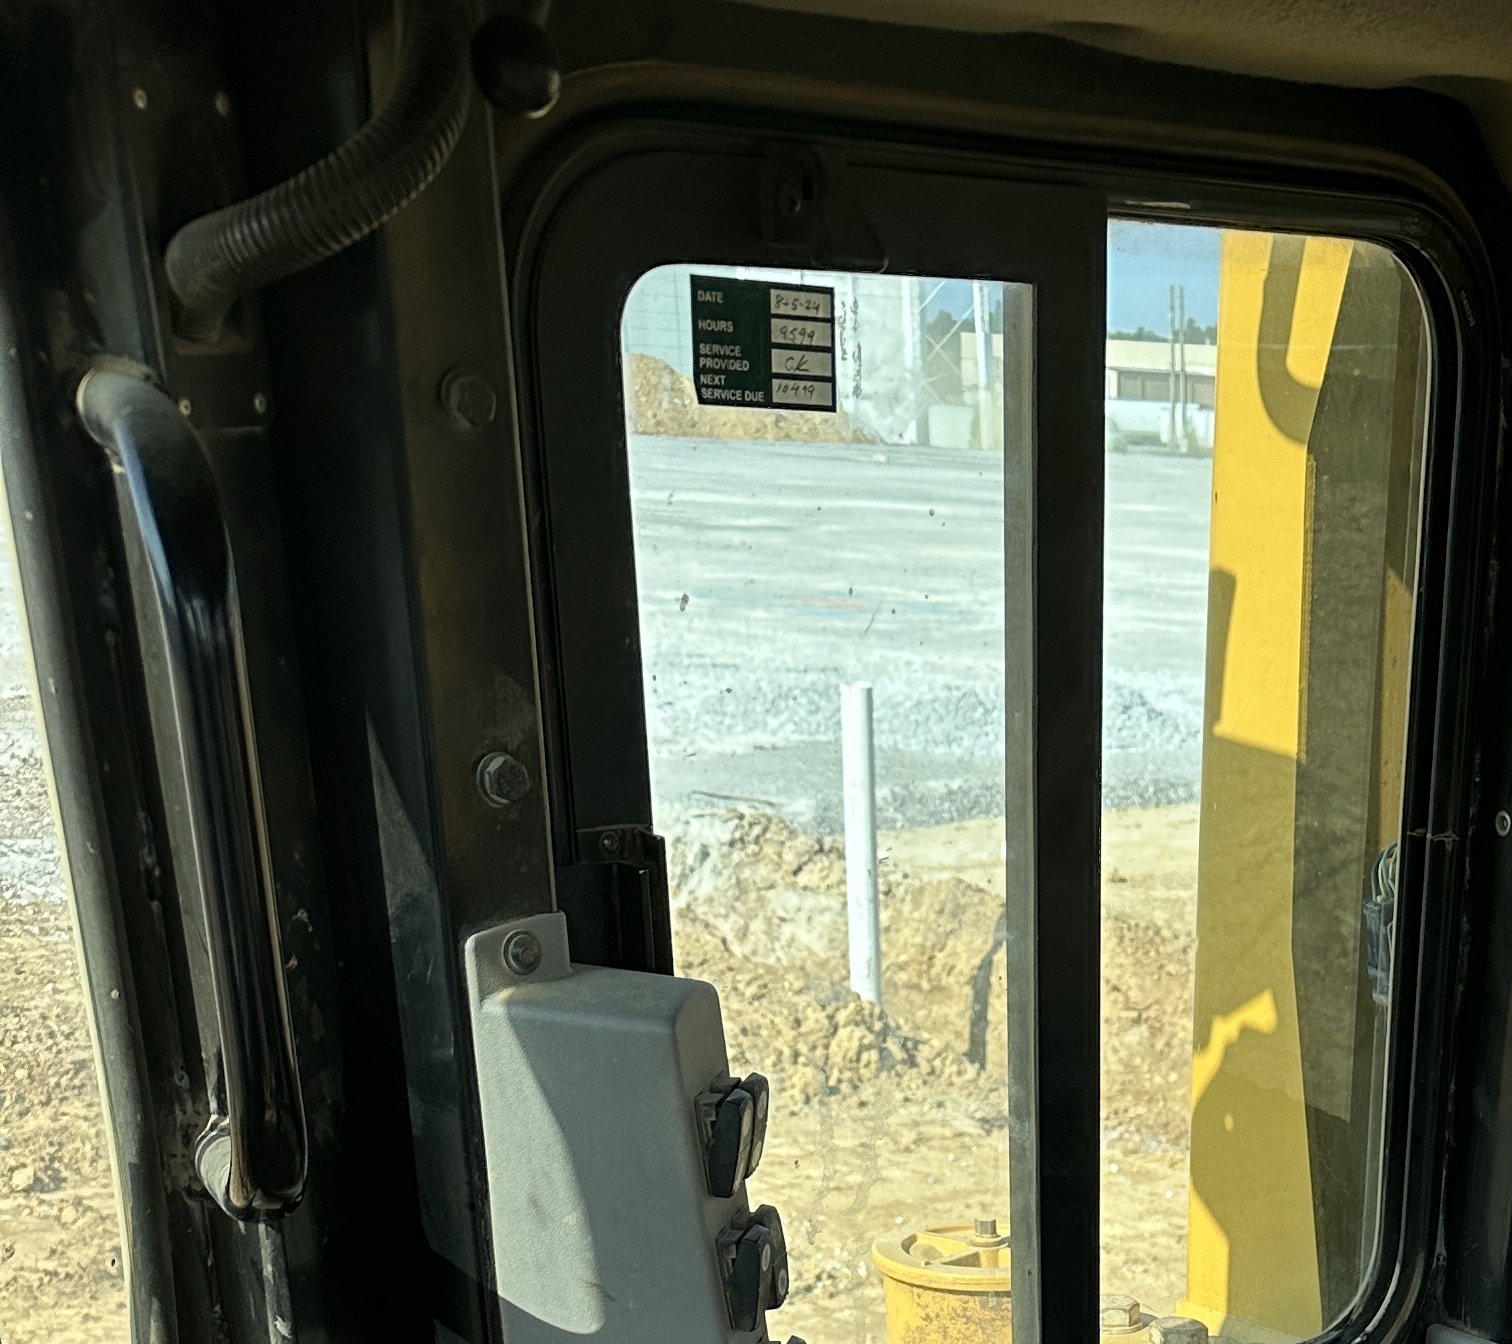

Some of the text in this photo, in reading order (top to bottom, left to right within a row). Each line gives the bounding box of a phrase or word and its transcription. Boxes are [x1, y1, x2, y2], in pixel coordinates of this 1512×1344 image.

[697, 290, 723, 303] DATE
[775, 294, 820, 315] 8-5-24
[698, 318, 734, 333] HOURS
[699, 343, 742, 357] SERVICE
[699, 357, 750, 372] PROVIDED
[700, 373, 726, 386] NEXT
[700, 387, 765, 402] SERVICE DUE
